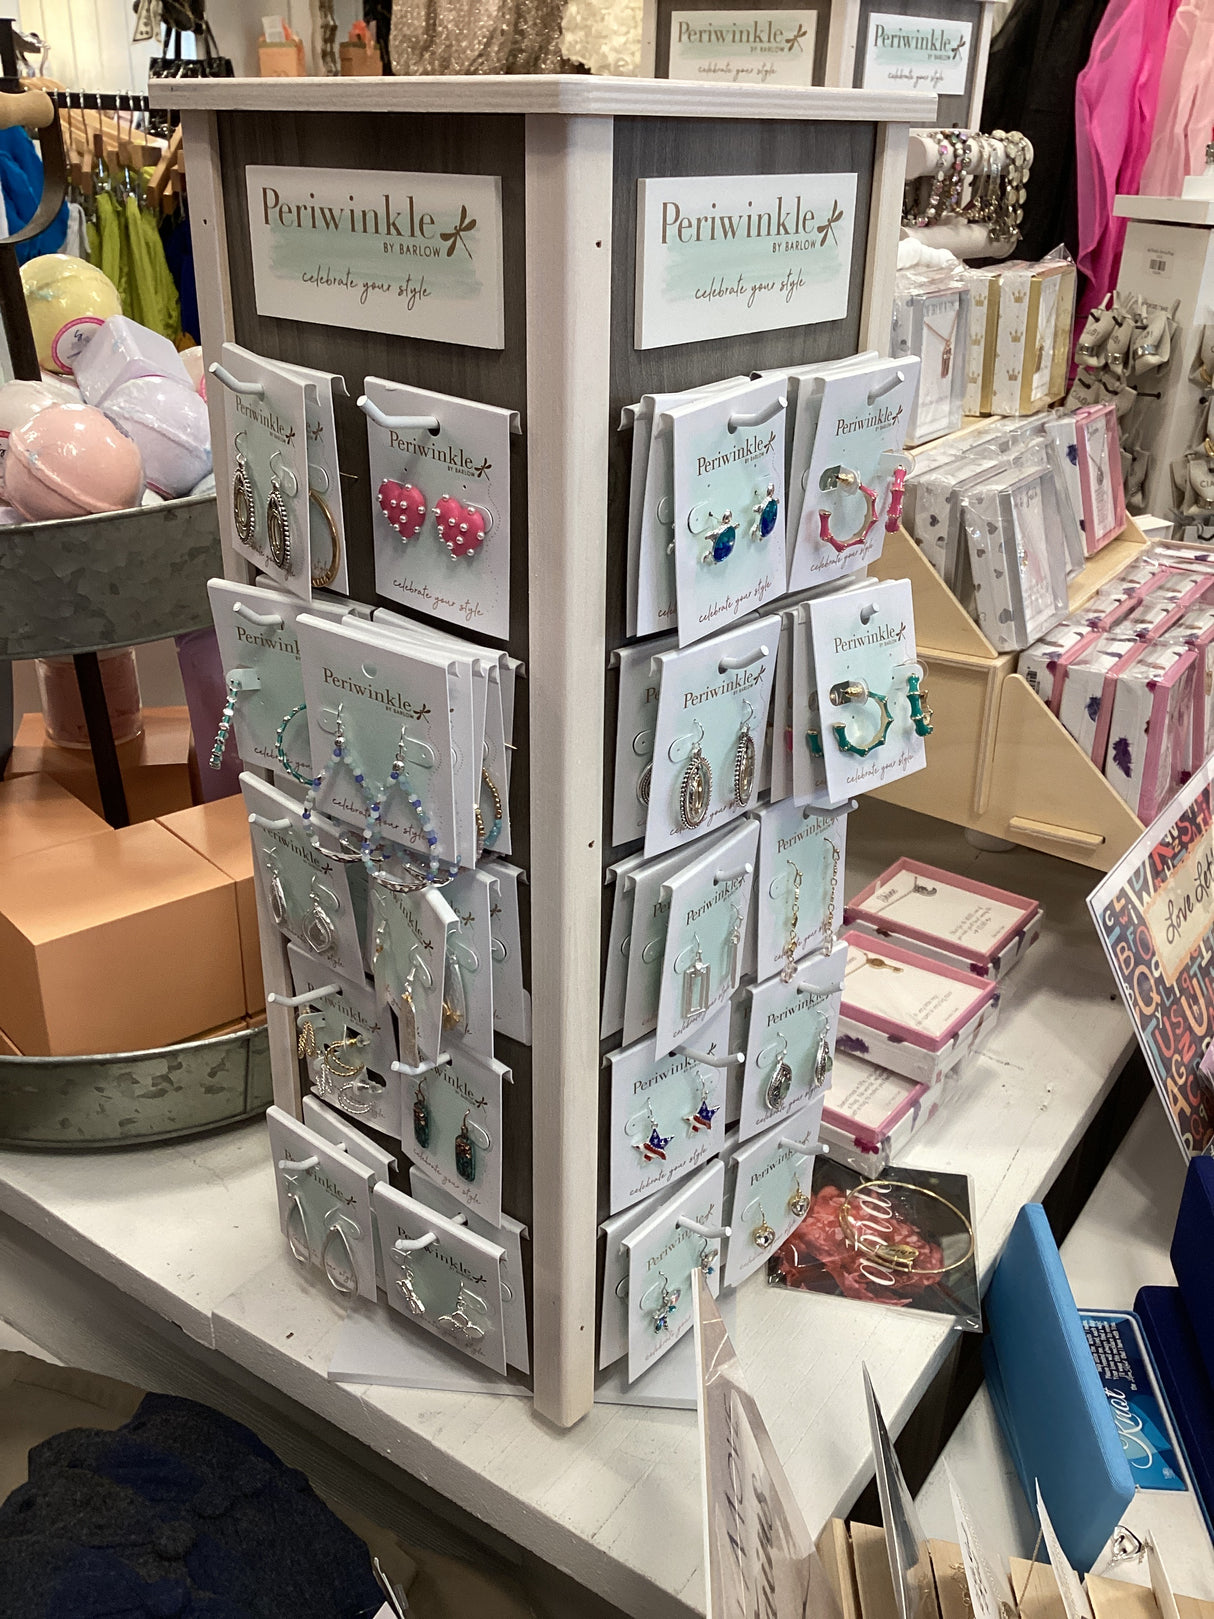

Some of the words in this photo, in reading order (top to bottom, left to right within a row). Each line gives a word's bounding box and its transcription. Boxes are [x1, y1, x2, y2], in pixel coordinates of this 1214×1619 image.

[677, 20, 784, 45] Periwinkle
[873, 24, 951, 51] Periwinkle
[697, 62, 733, 75] celebrate
[734, 67, 753, 79] your
[756, 62, 777, 77] style
[887, 70, 914, 82] celebrate
[929, 72, 944, 87] style
[261, 187, 436, 240] Periwinkle
[661, 195, 815, 245] Periwinkle
[383, 242, 395, 254] BY
[399, 243, 441, 258] BARLOW
[772, 242, 782, 253] BY
[784, 240, 817, 252] BARLOW
[301, 265, 358, 290] celebrate
[361, 280, 392, 305] your
[397, 274, 432, 311] style
[694, 273, 748, 302] celebrate
[747, 282, 776, 308] your
[779, 268, 807, 303] style
[235, 394, 285, 437] Periwinkle
[835, 406, 893, 437] Periwinkle
[389, 430, 474, 470] Periwinkle
[696, 435, 764, 477] Periwinkle
[455, 467, 475, 477] BARLOW
[810, 553, 843, 573] celebrate
[393, 578, 432, 599] celebrate
[432, 593, 456, 610] your
[459, 600, 484, 620] style
[699, 597, 733, 623] celebrate
[734, 590, 752, 612] your
[754, 576, 773, 599] style
[833, 623, 895, 654] Periwinkle
[322, 666, 412, 712] Periwinkle
[683, 669, 753, 709] Periwinkle
[846, 762, 880, 785] celebrate
[332, 797, 371, 819] celebrat
[263, 827, 320, 866] eriwinkle
[1165, 894, 1194, 944] Love
[1193, 848, 1214, 903] Let
[633, 1056, 697, 1095] Periwink
[629, 1166, 666, 1197] celebrate
